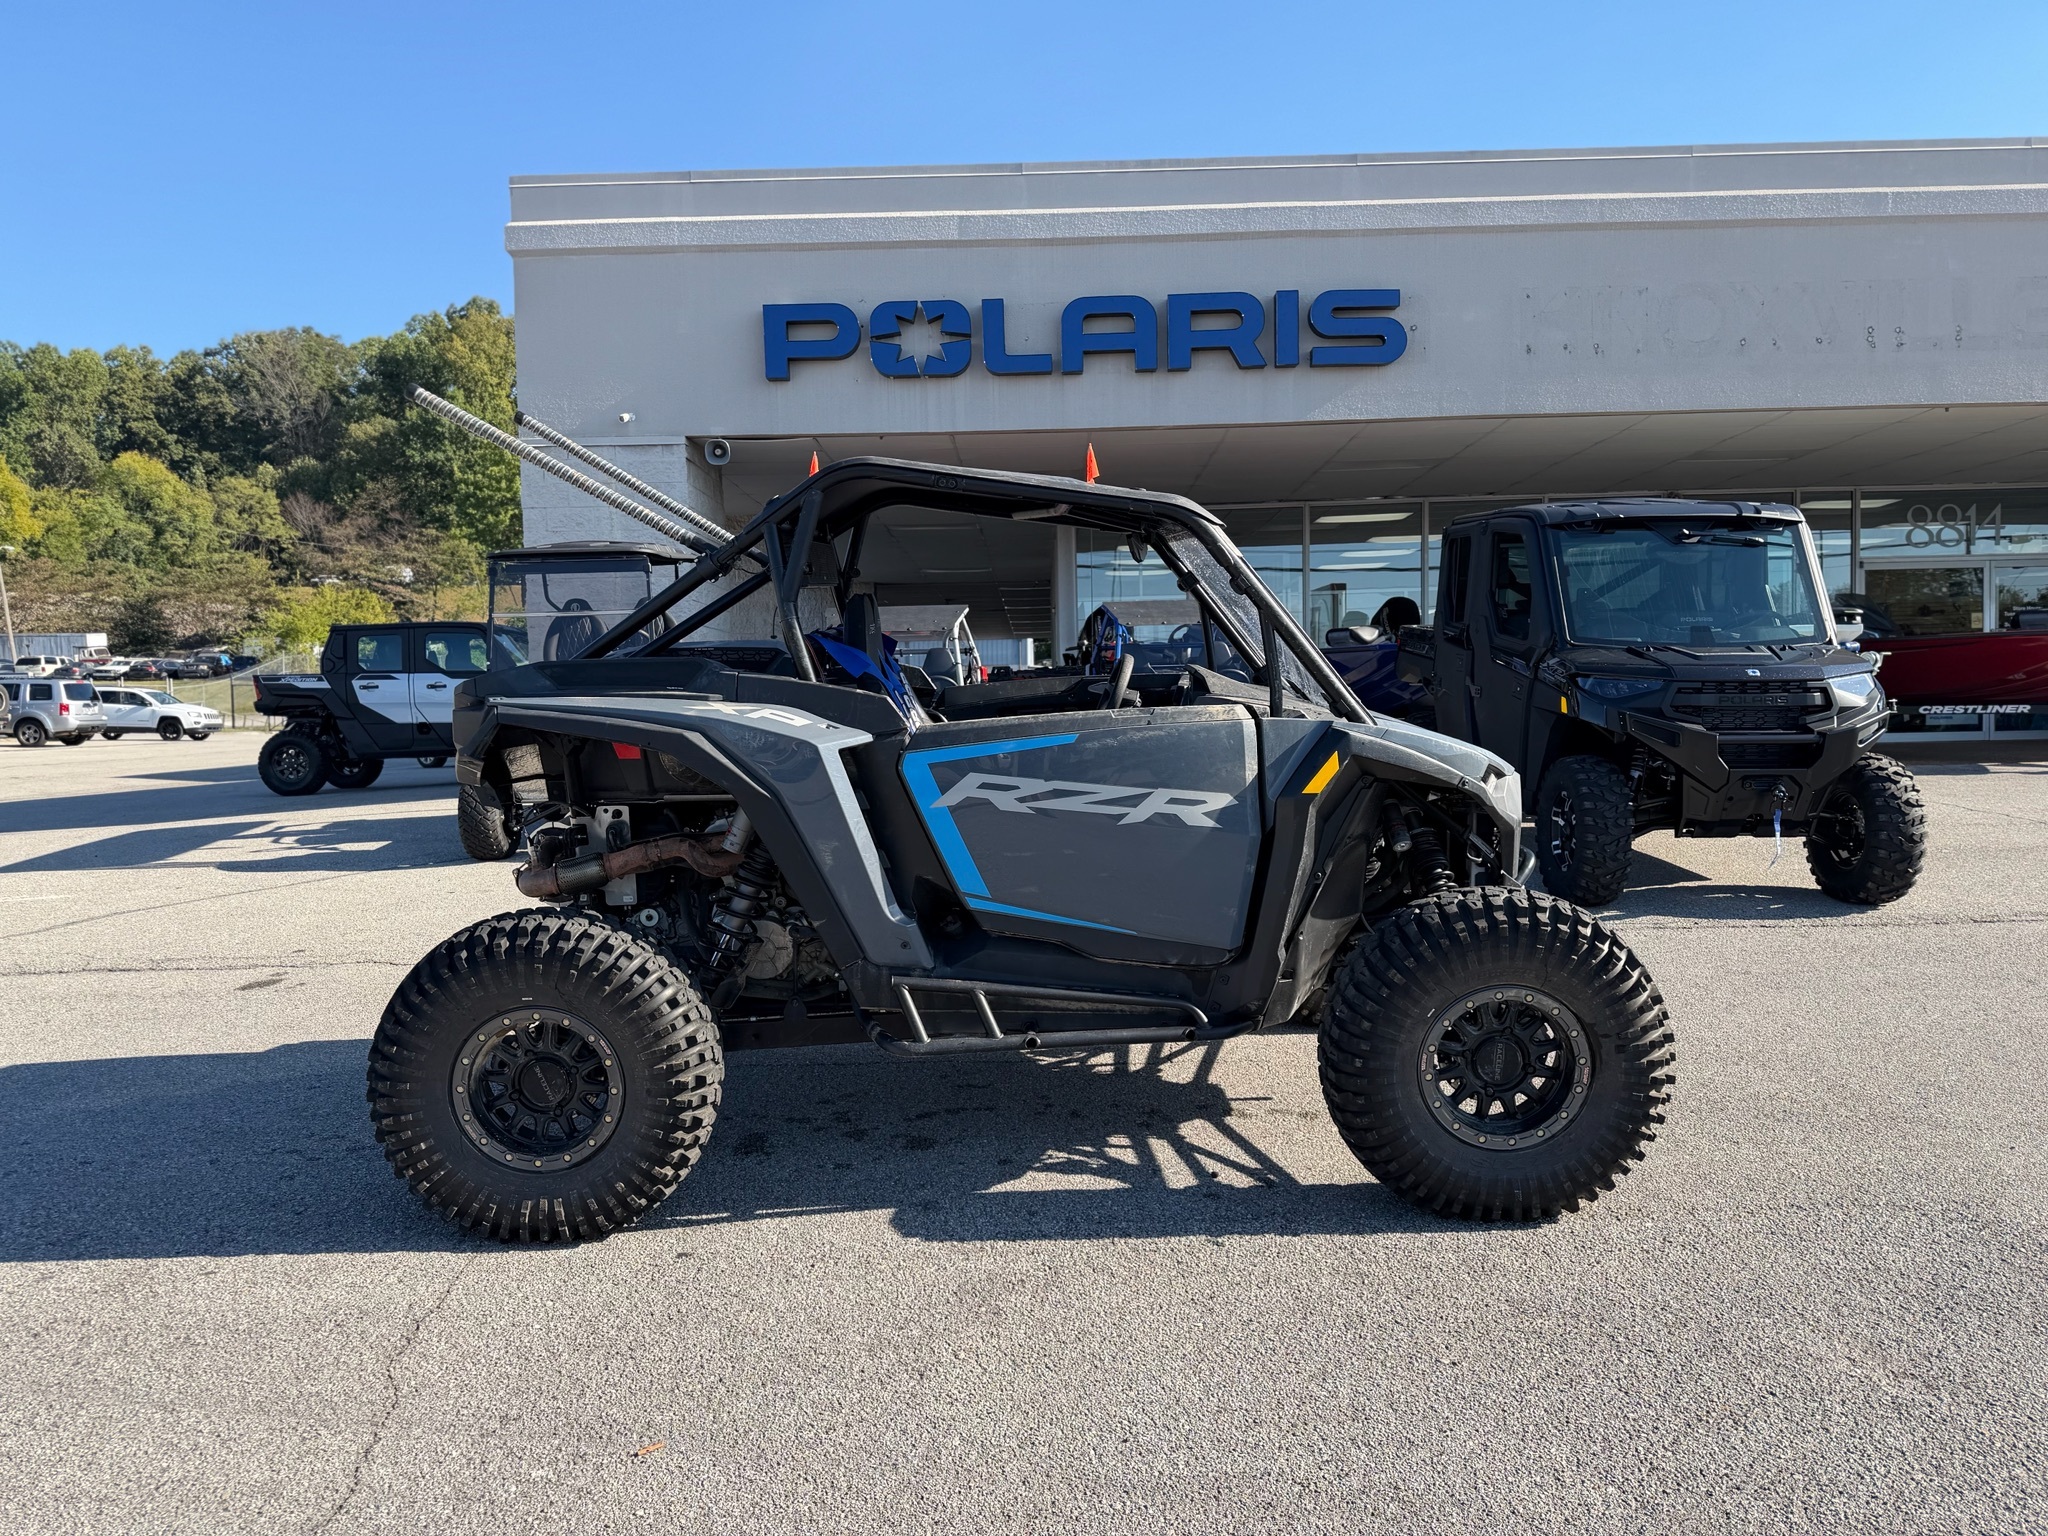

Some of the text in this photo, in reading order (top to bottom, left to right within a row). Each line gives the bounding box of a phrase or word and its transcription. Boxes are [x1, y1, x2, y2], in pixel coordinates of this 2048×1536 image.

[762, 288, 1408, 382] POLARIS
[1905, 502, 2006, 548] 8814
[682, 701, 814, 727] XP
[1718, 694, 1788, 705] POLARIS
[1918, 704, 2032, 714] CRESTLINER
[929, 772, 1239, 829] RZR
[1494, 1043, 1503, 1081] RACELINE
[533, 1065, 555, 1101] RACELINE
